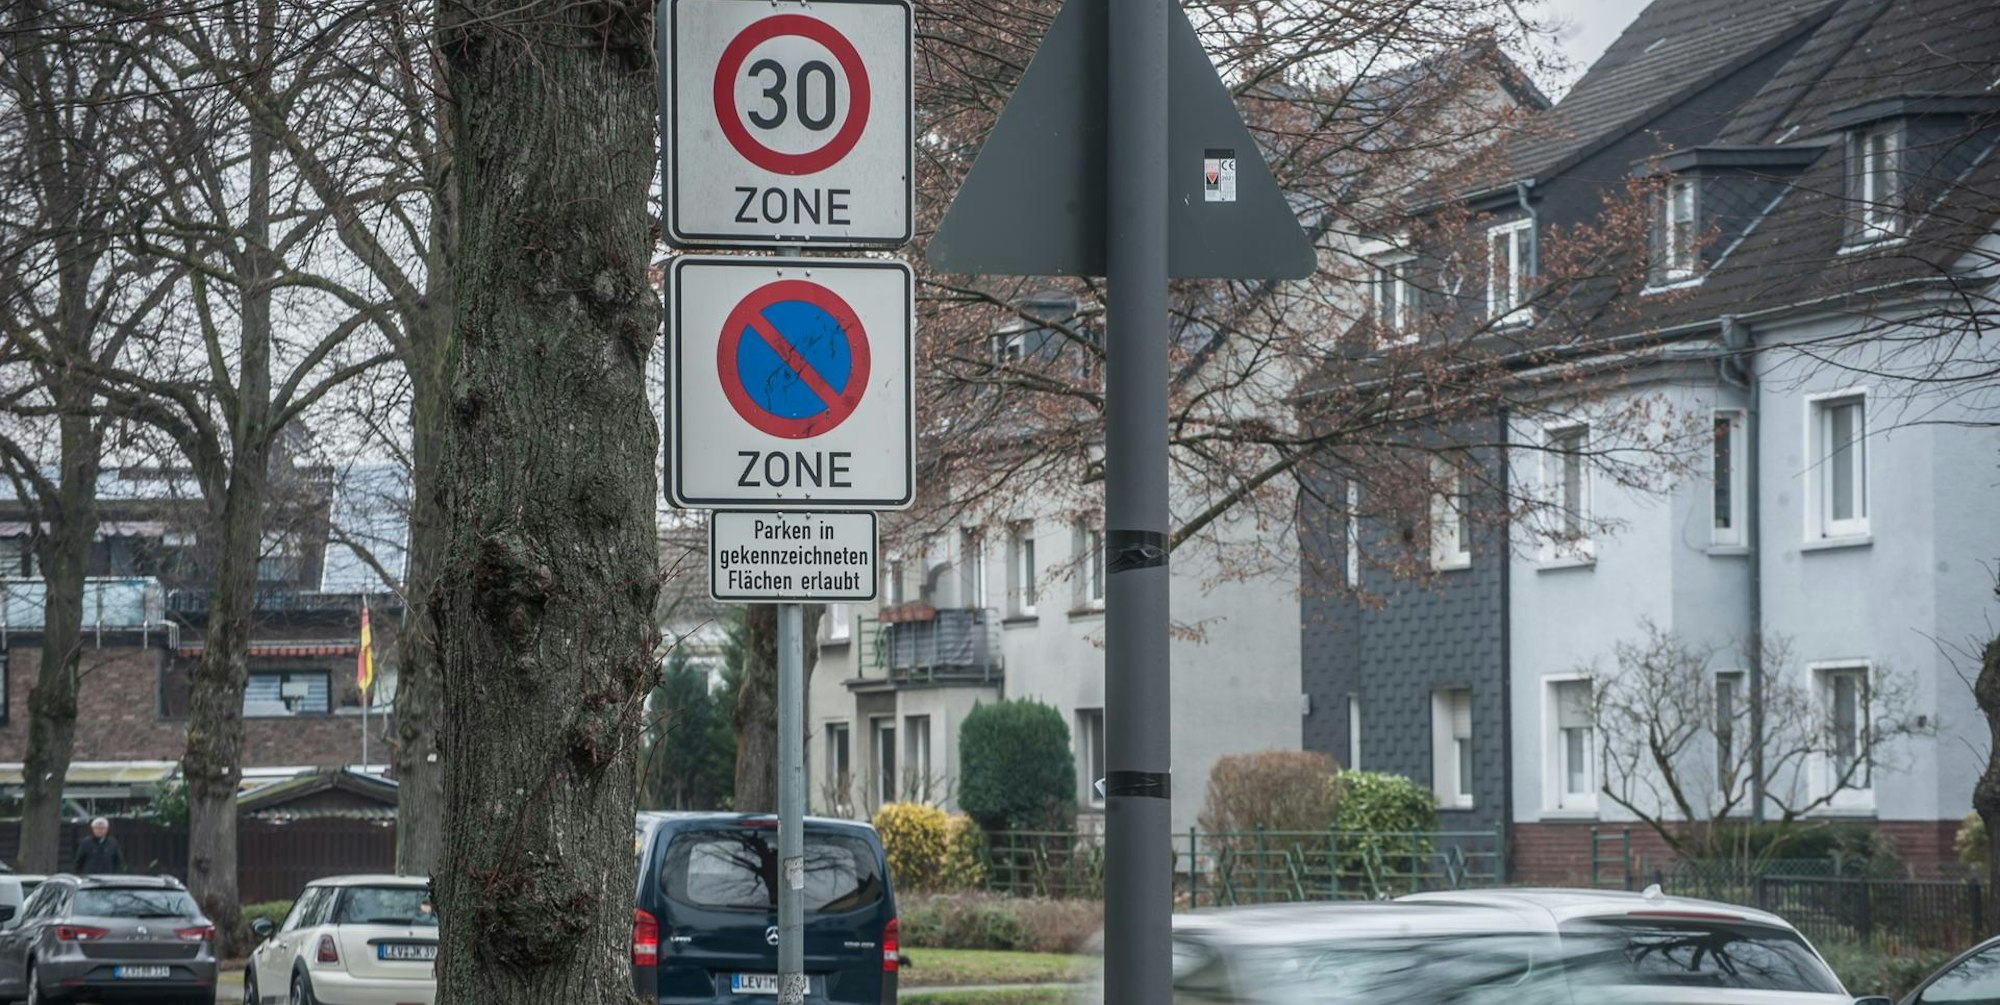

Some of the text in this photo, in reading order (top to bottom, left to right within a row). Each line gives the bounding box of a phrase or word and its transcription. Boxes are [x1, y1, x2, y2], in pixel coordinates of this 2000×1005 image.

[748, 58, 836, 131] 30
[1221, 160, 1235, 171] CE
[734, 186, 851, 225] ZONE
[737, 451, 853, 488] ZONE
[754, 520, 834, 540] Parken in
[720, 545, 868, 569] gekennzeichneten
[728, 570, 860, 591] Flächen erlaubt
[384, 946, 403, 958] LEV
[741, 976, 761, 989] LEV
